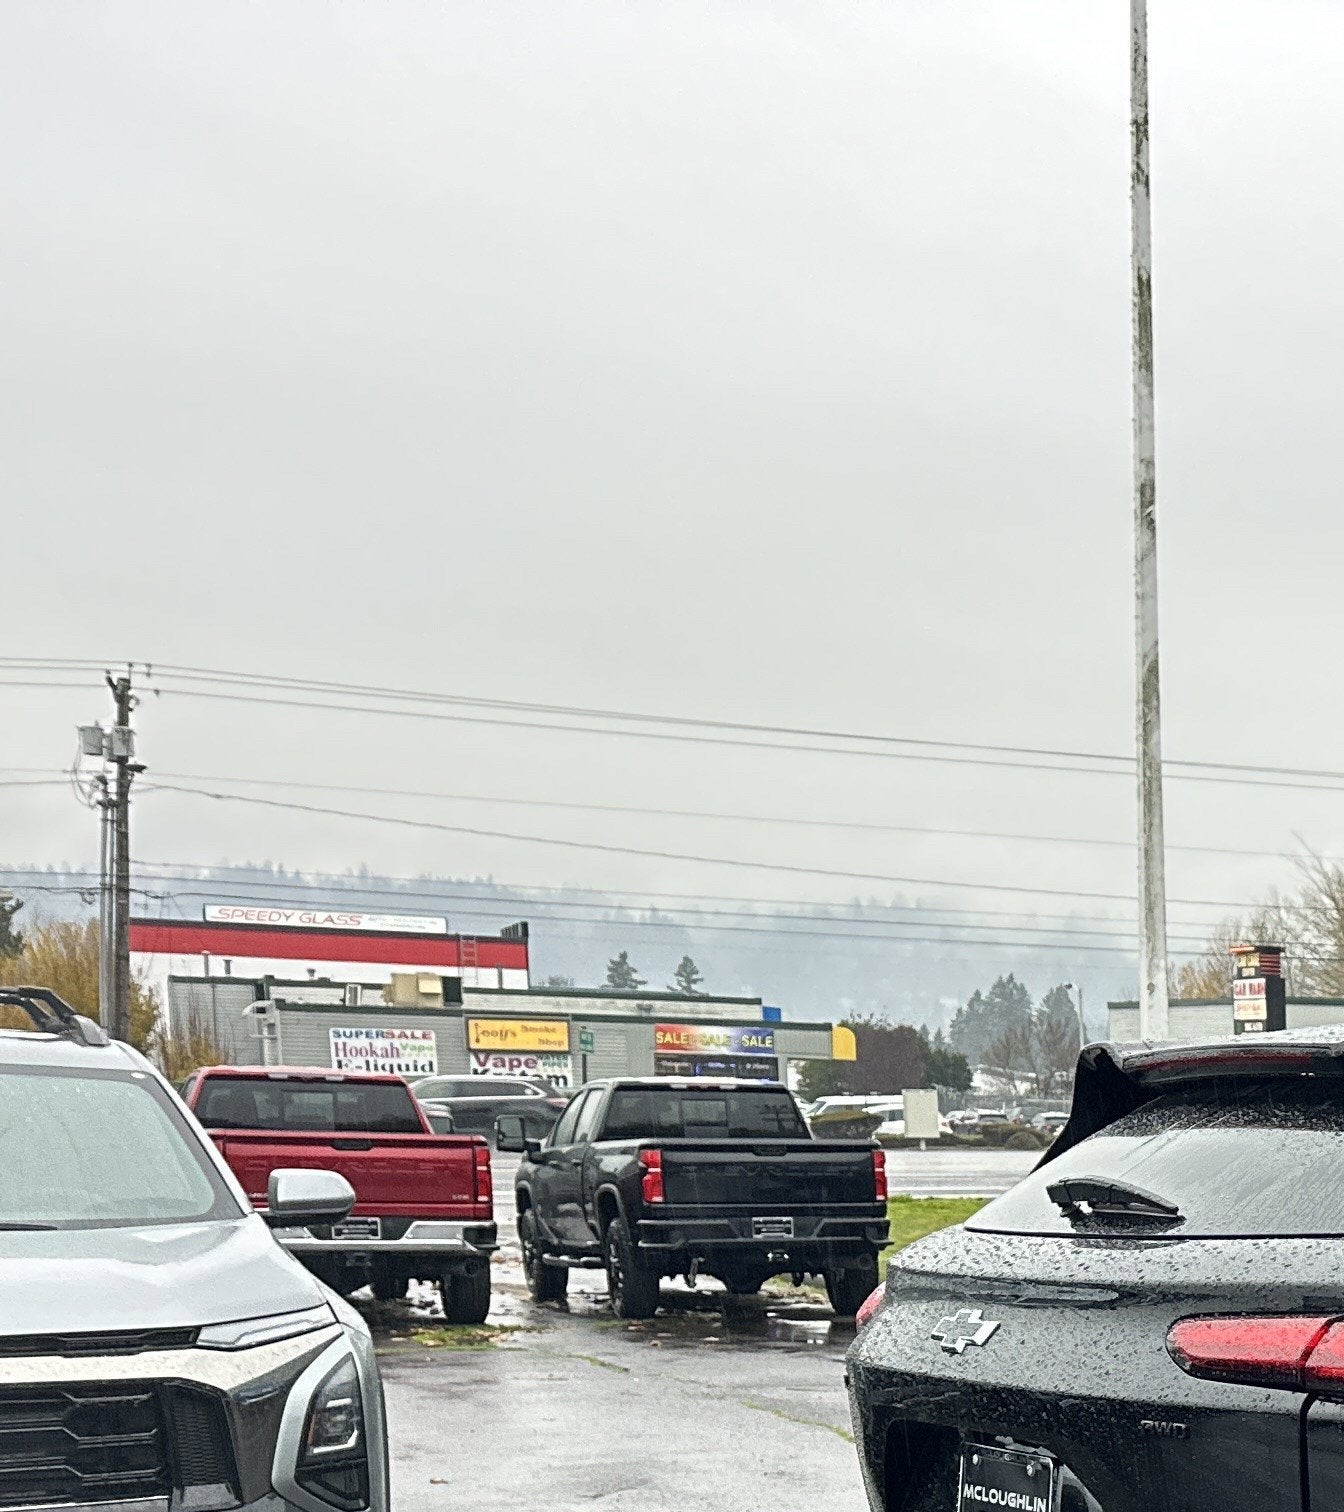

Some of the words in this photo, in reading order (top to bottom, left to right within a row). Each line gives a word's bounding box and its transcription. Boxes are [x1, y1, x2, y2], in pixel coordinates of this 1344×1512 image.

[211, 908, 295, 922] SPEEDY
[299, 912, 363, 926] GLASS
[656, 1031, 689, 1045] SALE
[698, 1033, 732, 1047] SALE
[741, 1034, 773, 1048] SALE
[334, 1041, 401, 1058] Hookah
[474, 1051, 538, 1072] Vape
